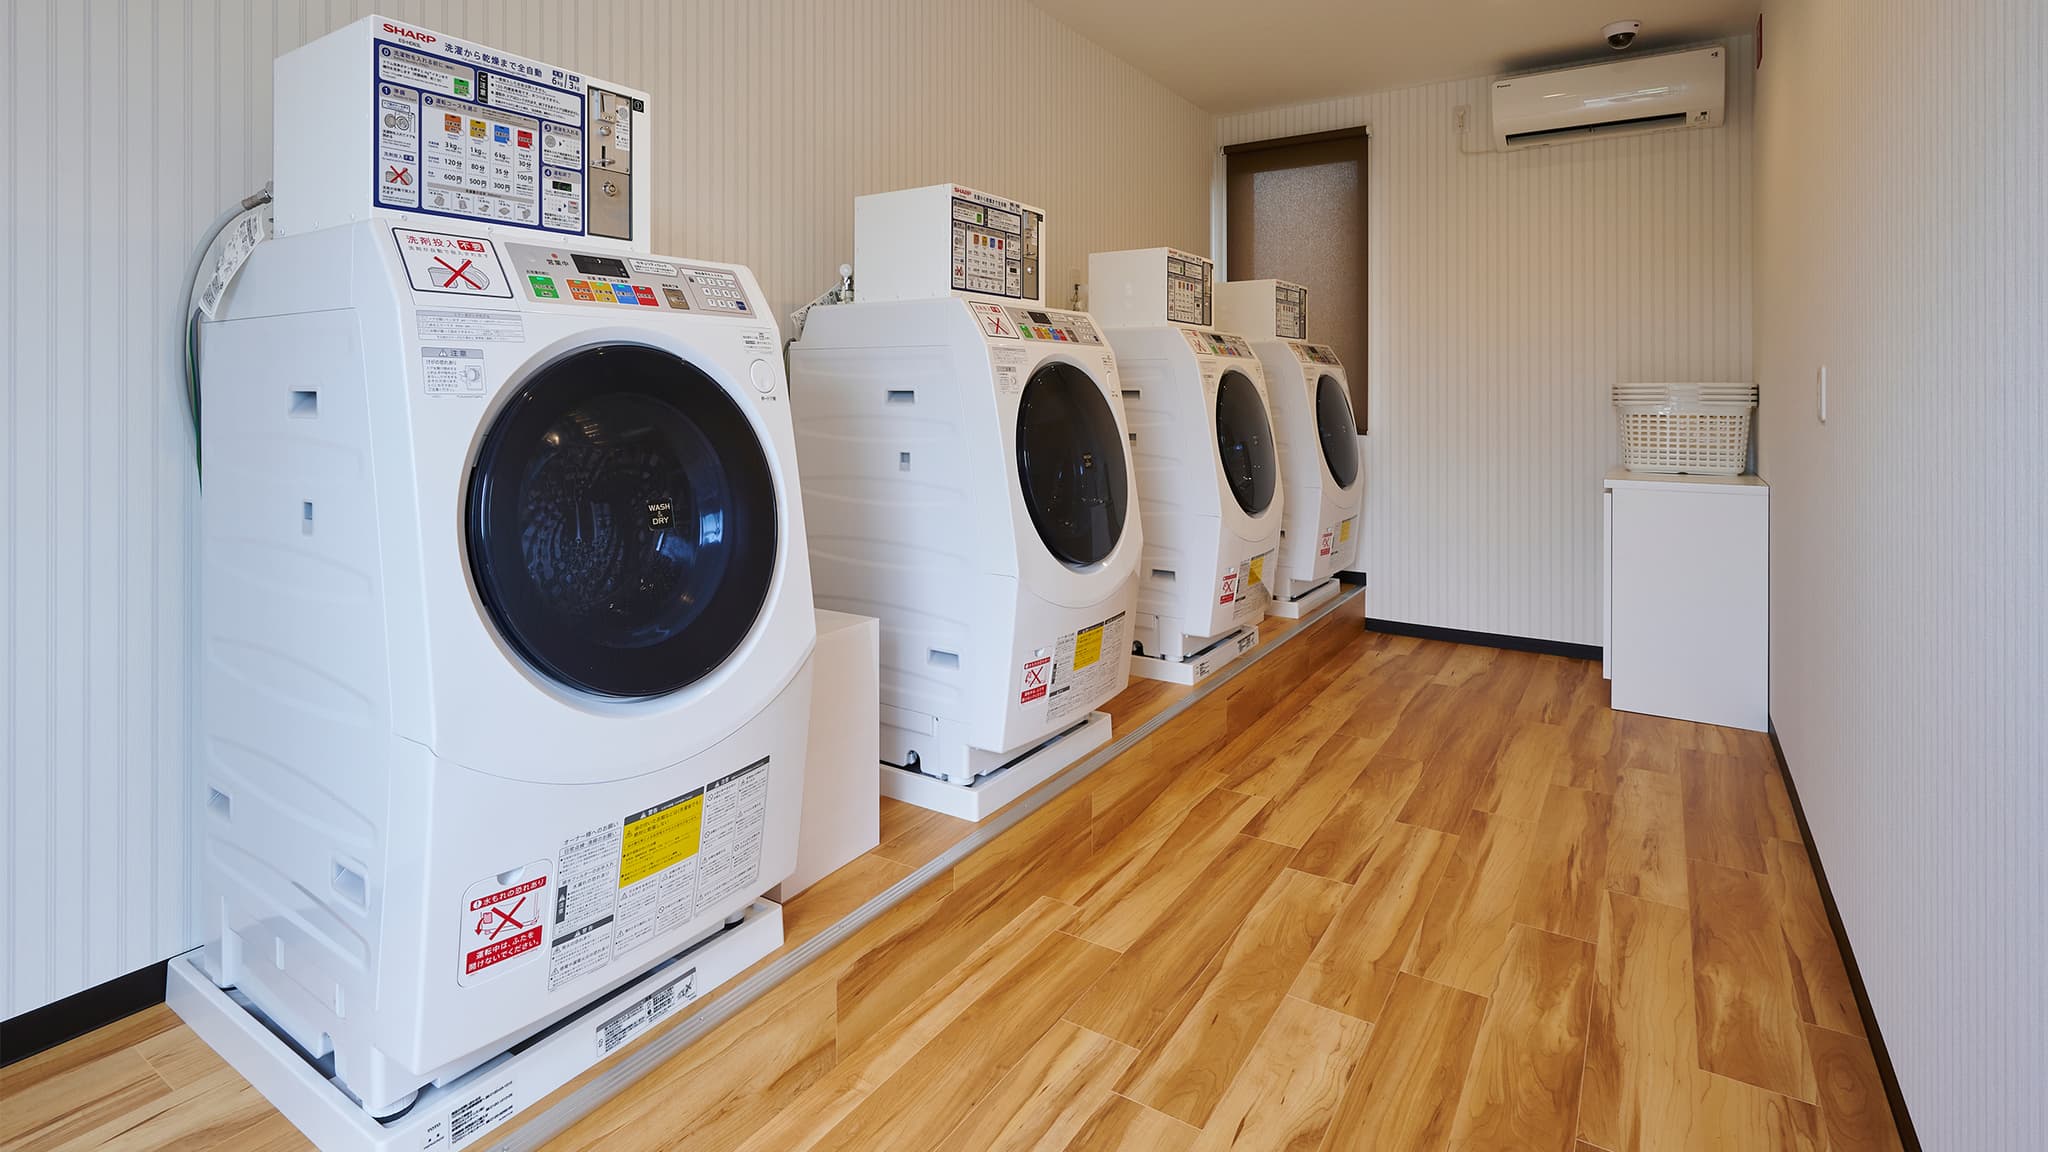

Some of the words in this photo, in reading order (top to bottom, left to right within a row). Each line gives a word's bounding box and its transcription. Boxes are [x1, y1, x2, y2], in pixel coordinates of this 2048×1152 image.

[383, 23, 437, 44] SHARP
[444, 42, 543, 78] 洗濯から乾燥まで全自動
[444, 158, 462, 168] 120分
[443, 173, 462, 182] 600円
[469, 178, 487, 187] 500円
[517, 174, 533, 183] 100円
[494, 182, 511, 192] 300円
[407, 235, 457, 248] 洗剤投入
[648, 503, 671, 512] WASH
[652, 516, 669, 525] DRY
[483, 878, 544, 906] 水もれの恐れあり
[475, 931, 534, 960] 運転中は、ふたを
[468, 939, 539, 972] 開けないでください。
